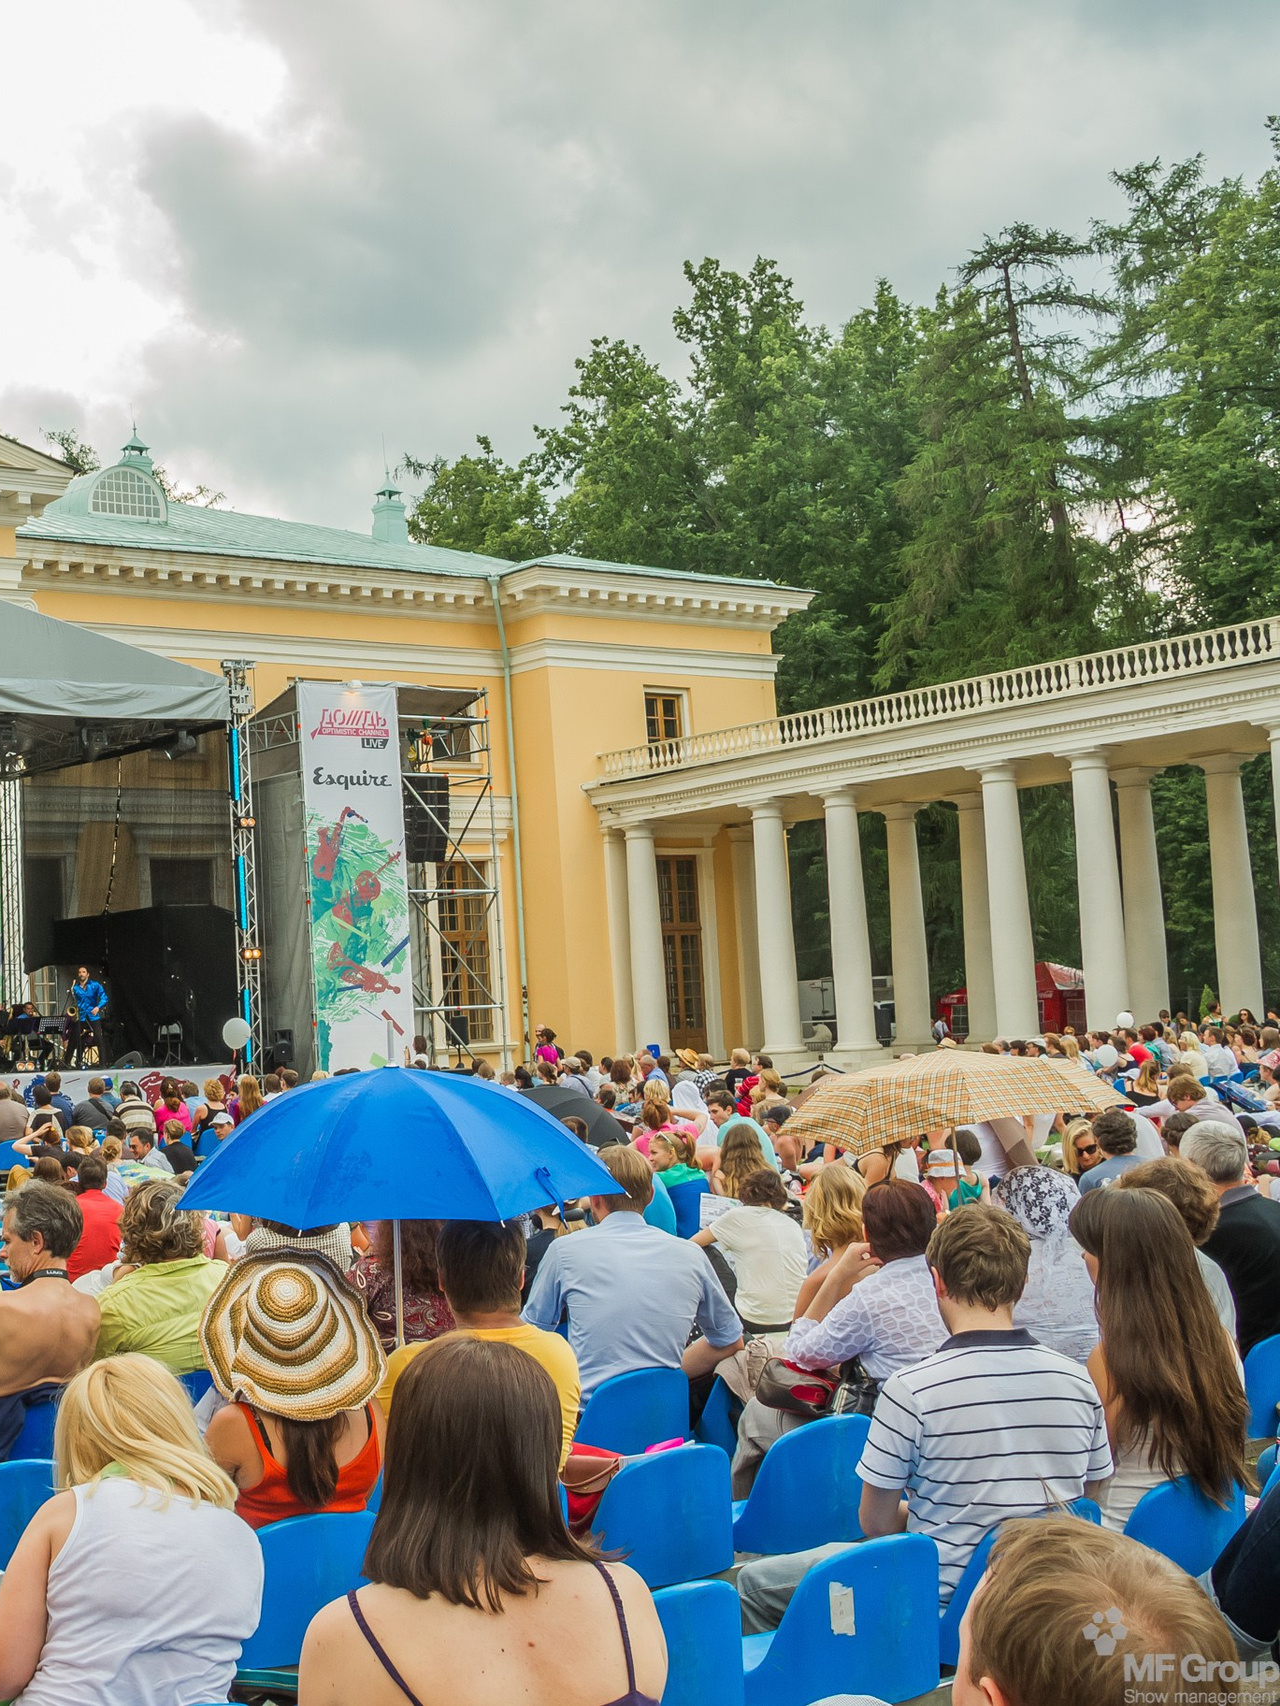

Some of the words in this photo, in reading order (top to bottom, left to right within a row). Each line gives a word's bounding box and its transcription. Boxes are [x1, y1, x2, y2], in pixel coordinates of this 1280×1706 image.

[322, 728, 356, 736] OPTIMISTIC
[358, 729, 387, 737] CHANNEL
[364, 739, 384, 749] LIVE
[312, 766, 392, 790] Esquire
